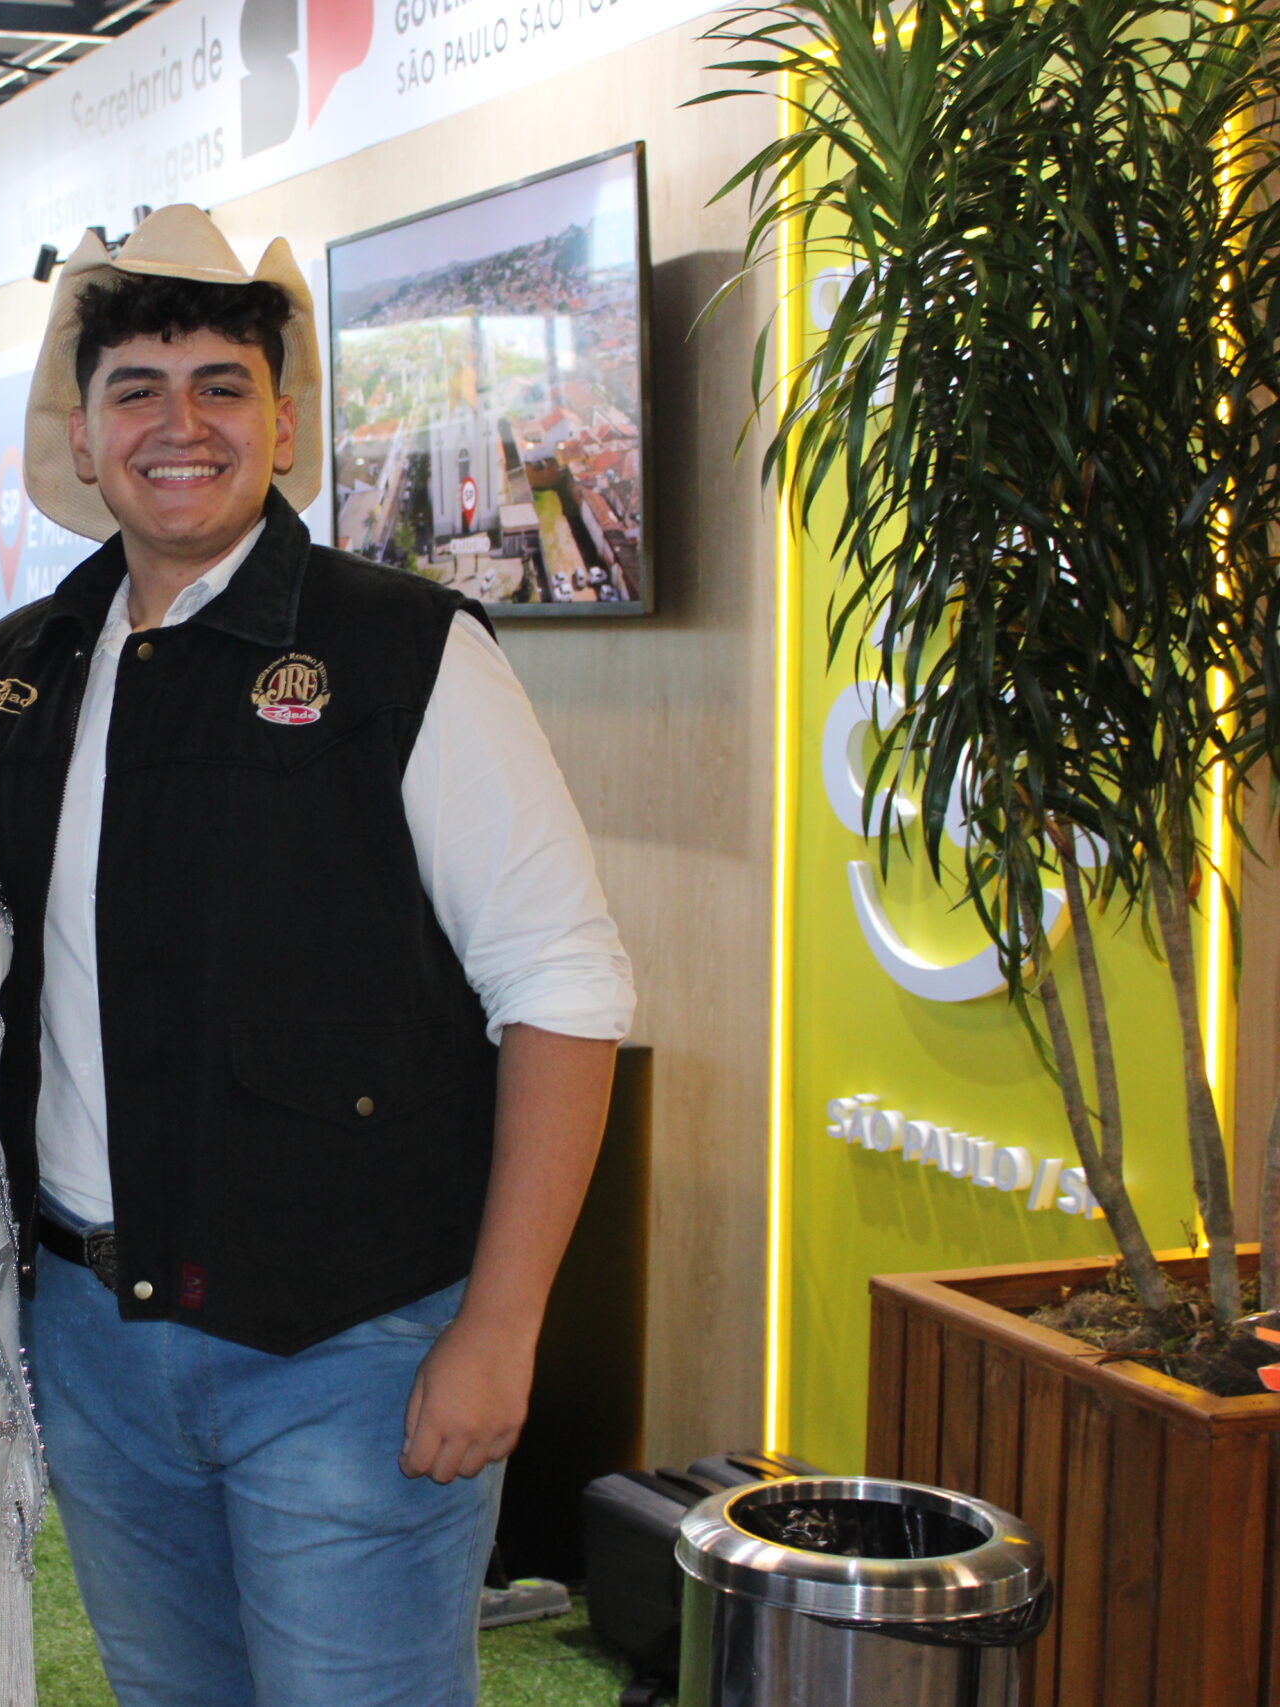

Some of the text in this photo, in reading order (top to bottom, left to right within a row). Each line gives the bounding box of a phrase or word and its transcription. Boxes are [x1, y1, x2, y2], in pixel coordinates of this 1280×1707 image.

[71, 16, 223, 145] Secretaria de
[397, 48, 435, 95] SÃO
[444, 18, 508, 75] PAULO
[0, 487, 21, 527] SP
[826, 1093, 904, 1152] SÃO
